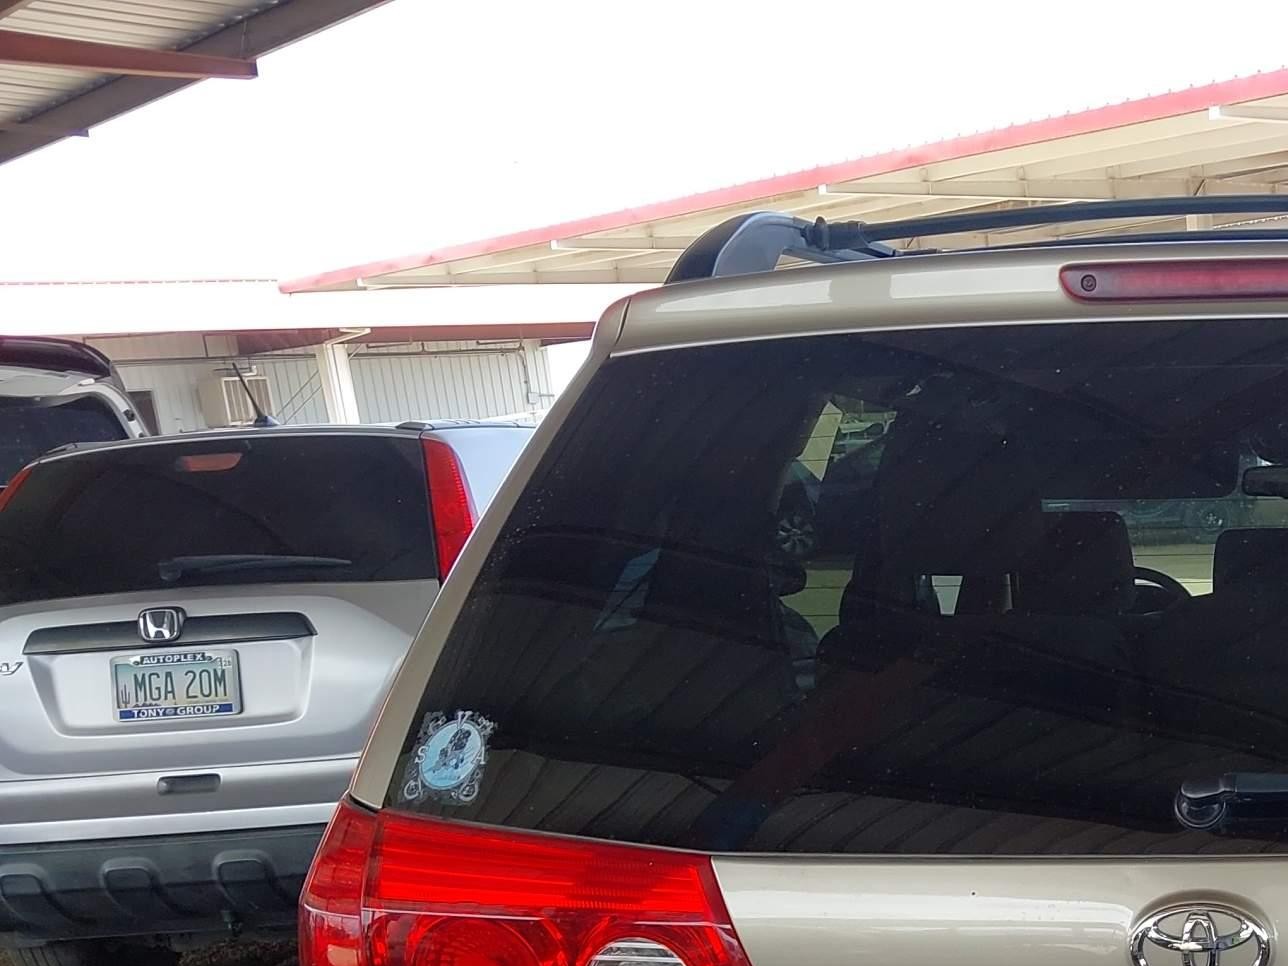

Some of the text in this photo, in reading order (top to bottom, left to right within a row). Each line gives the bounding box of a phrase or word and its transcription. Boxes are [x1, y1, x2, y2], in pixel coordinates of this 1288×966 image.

[142, 653, 204, 665] AUTOPLEX
[133, 671, 177, 703] MGA
[132, 705, 220, 719] TONY GROUP
